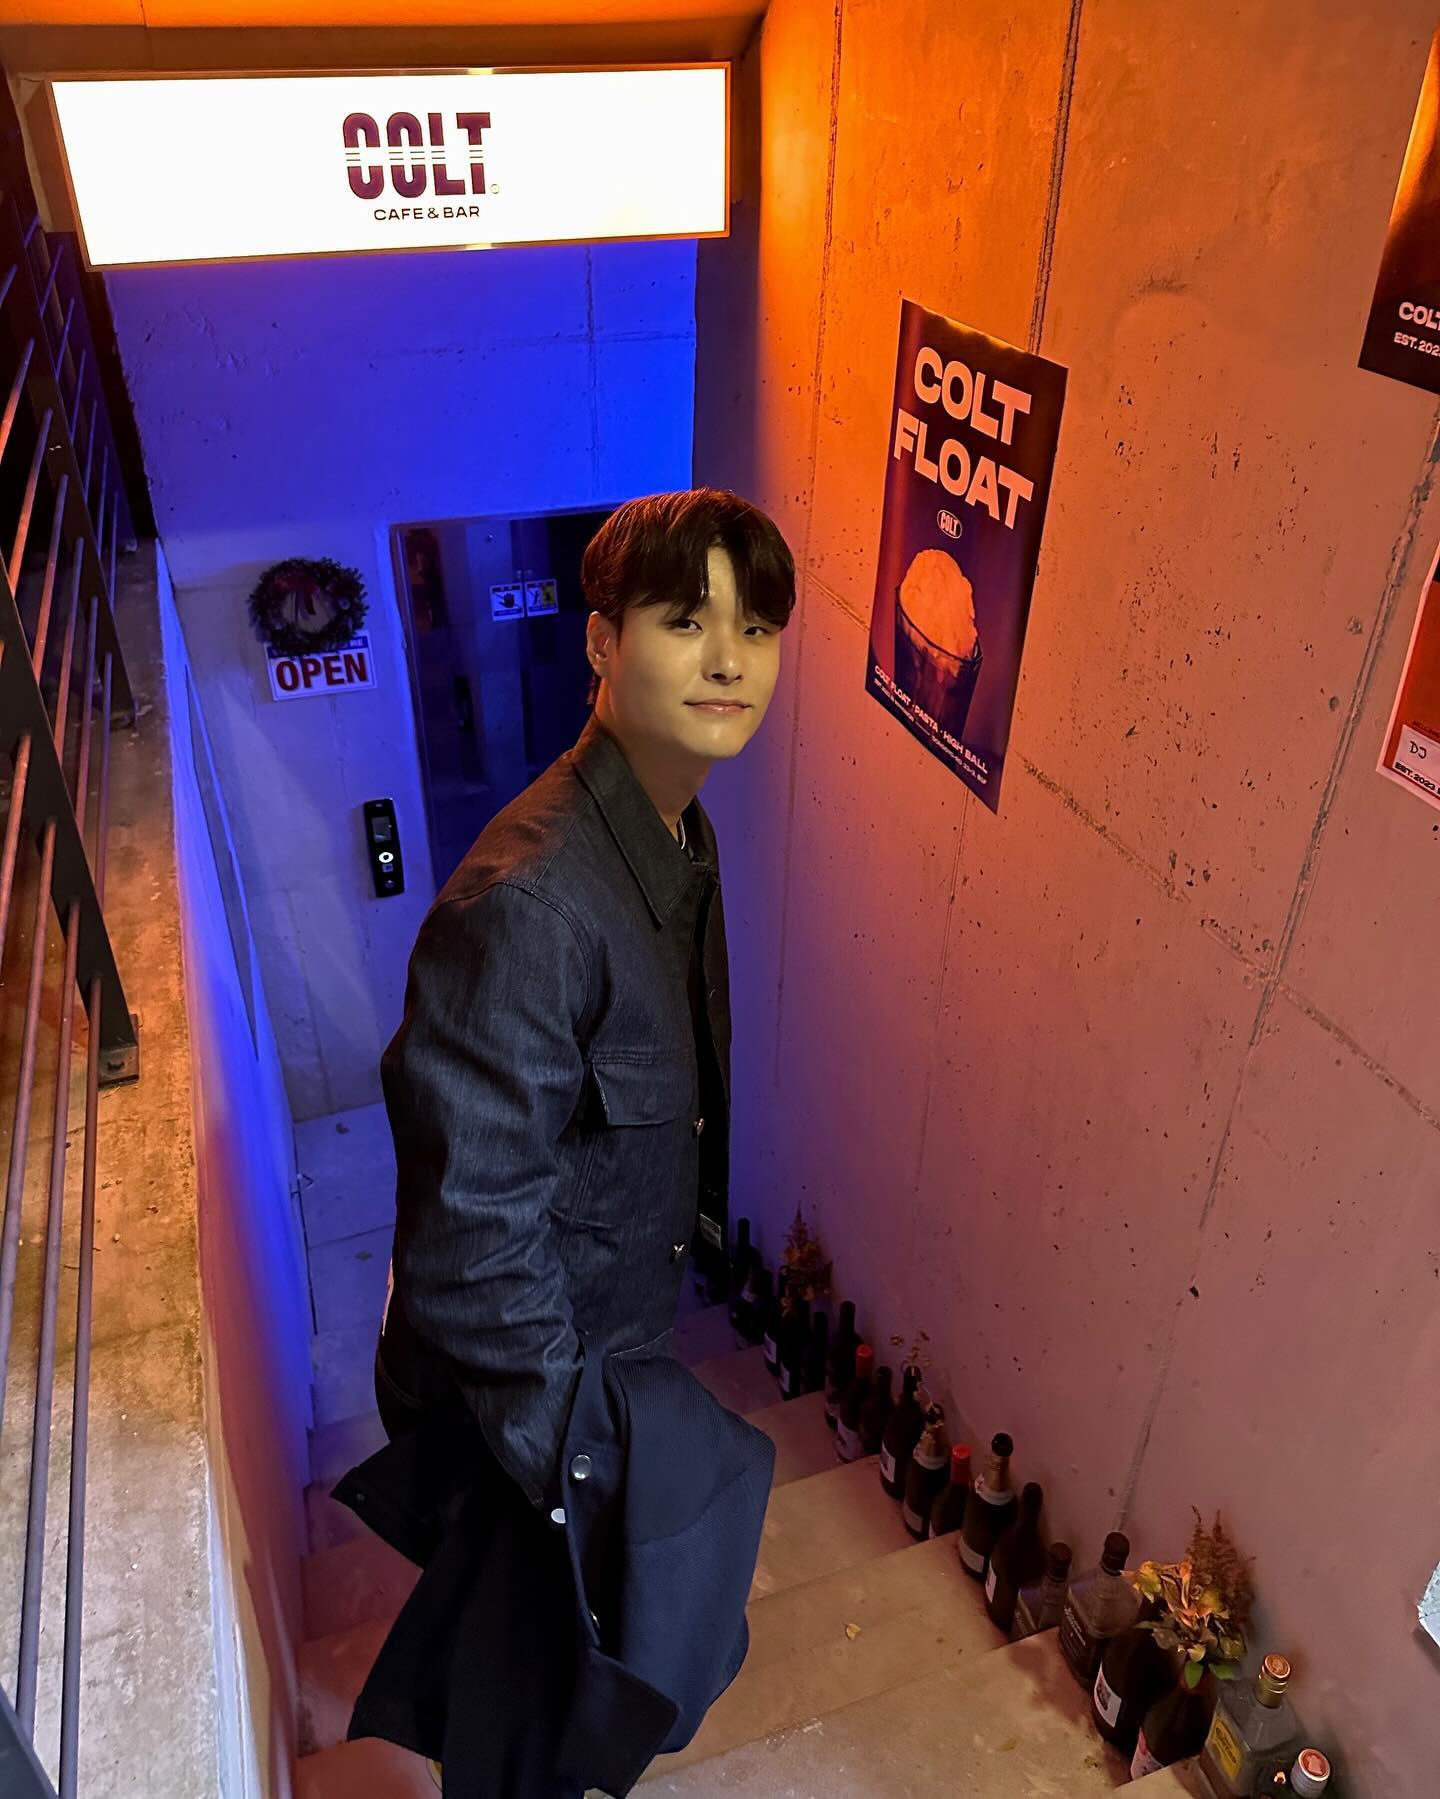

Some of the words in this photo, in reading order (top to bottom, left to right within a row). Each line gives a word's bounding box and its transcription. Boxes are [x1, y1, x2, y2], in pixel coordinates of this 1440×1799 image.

[342, 111, 491, 199] COLT
[914, 346, 1032, 445] COLT
[893, 408, 1034, 530] FLOAT
[940, 511, 959, 537] COLT
[276, 652, 368, 692] OPEN
[891, 681, 911, 705] FLOAT
[914, 704, 939, 732] PASTA
[943, 730, 964, 754] HIGH
[964, 749, 988, 774] BALL
